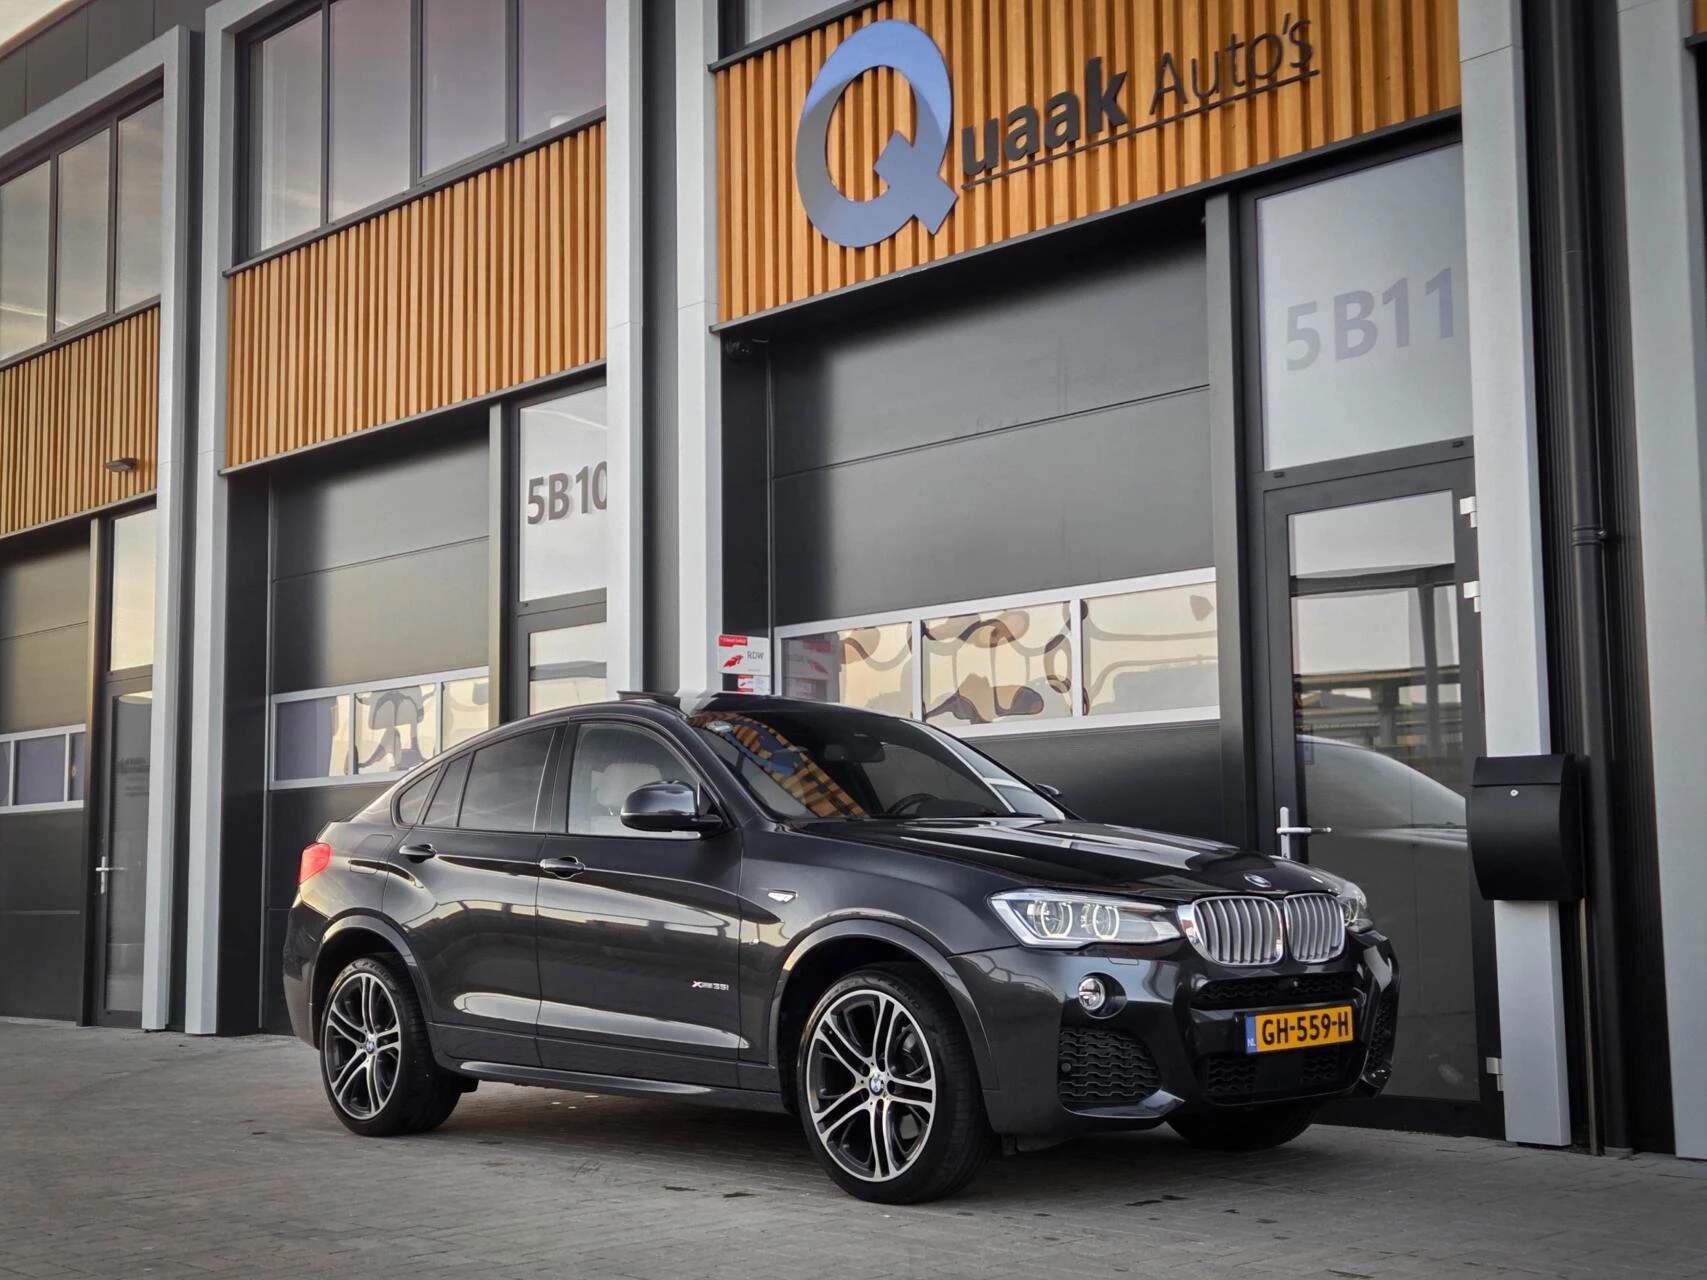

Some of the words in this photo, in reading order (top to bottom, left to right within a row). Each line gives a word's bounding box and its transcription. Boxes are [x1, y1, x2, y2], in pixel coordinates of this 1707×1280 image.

[795, 18, 1128, 248] Quaak
[1149, 13, 1312, 115] Auto's
[1286, 266, 1454, 371] 5B11
[527, 460, 608, 525] 5B10
[747, 651, 764, 660] RDW
[1262, 1011, 1348, 1045] GH-559-H
